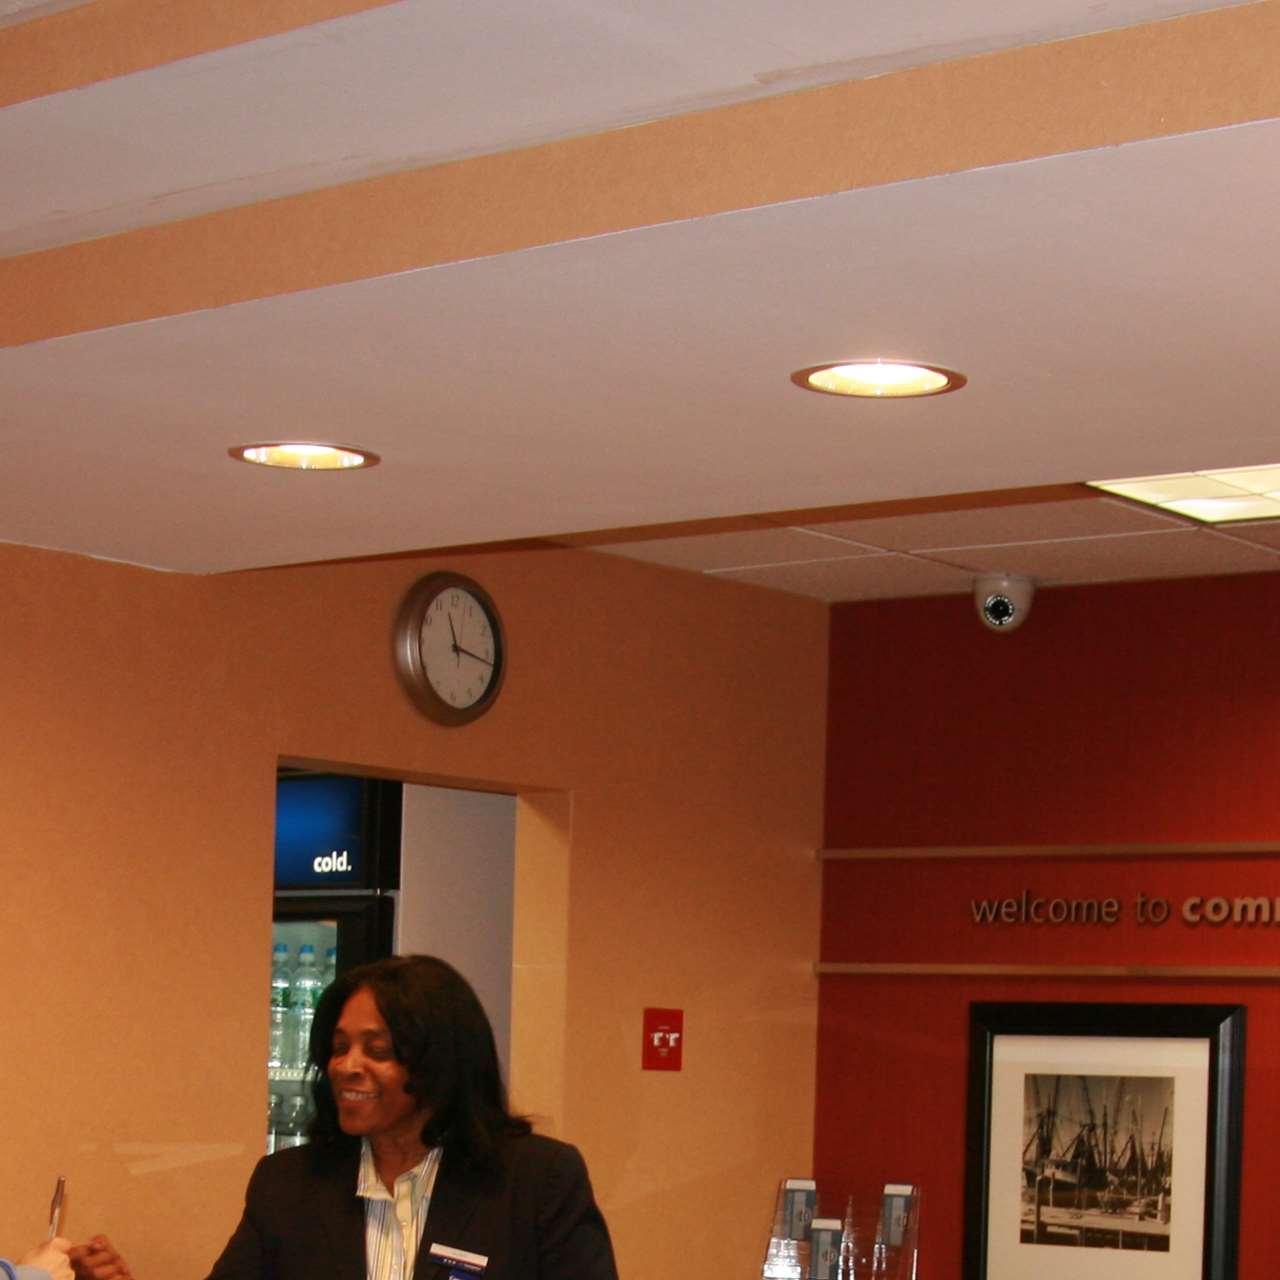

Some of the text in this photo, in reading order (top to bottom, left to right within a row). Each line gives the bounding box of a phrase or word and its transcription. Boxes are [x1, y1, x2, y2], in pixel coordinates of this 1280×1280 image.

[313, 850, 352, 873] cold.
[970, 889, 1120, 924] welcome
[1136, 891, 1170, 924] to
